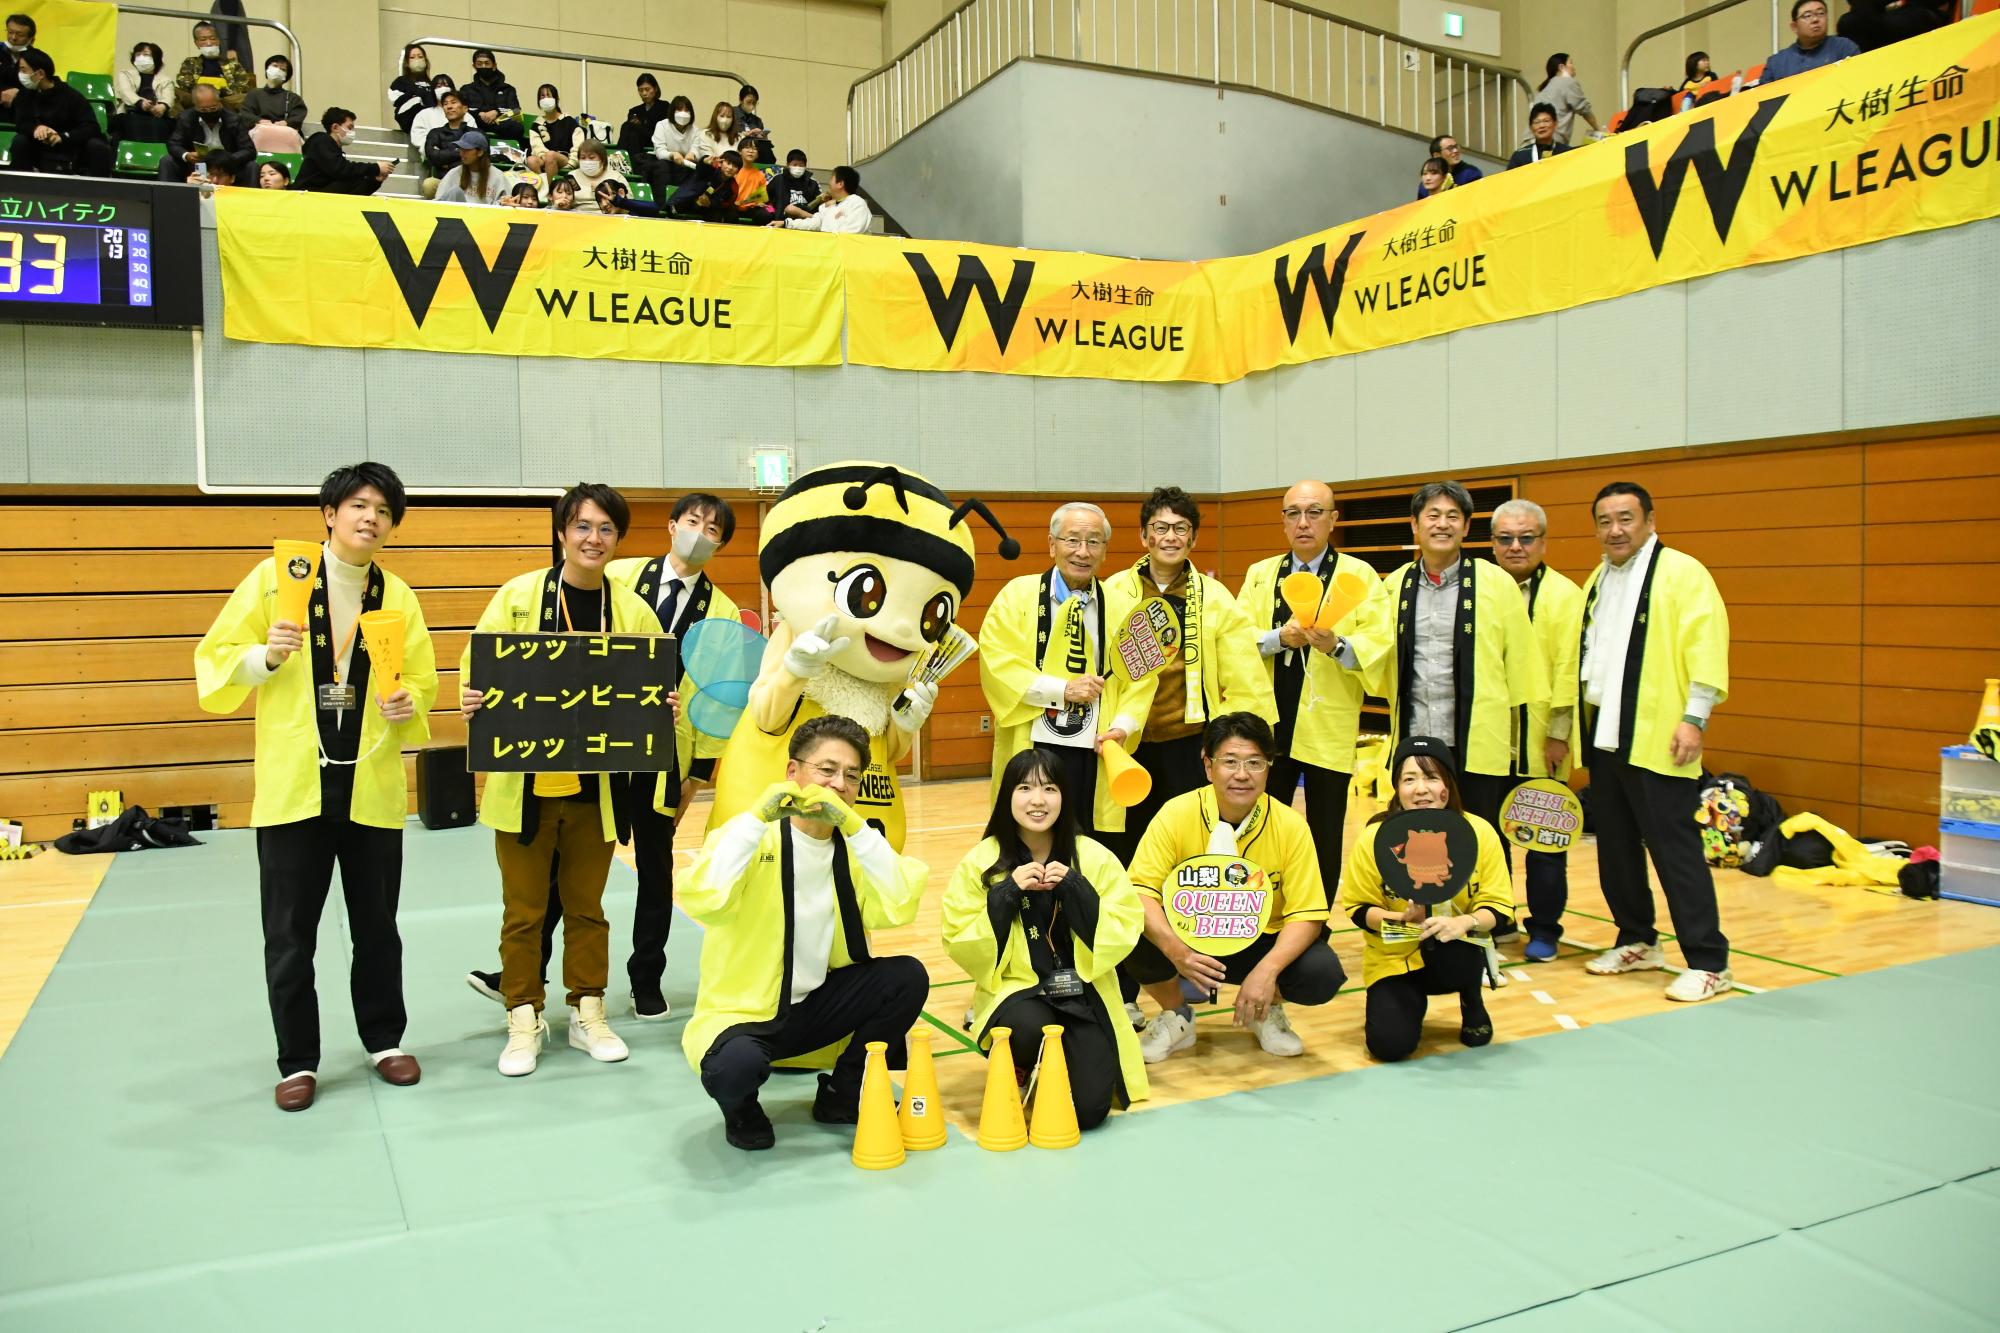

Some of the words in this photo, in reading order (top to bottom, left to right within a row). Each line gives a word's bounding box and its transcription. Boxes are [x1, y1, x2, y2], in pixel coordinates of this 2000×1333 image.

[1825, 65, 1968, 131] 大樹生命
[1625, 94, 1790, 262] W
[1770, 165, 1818, 211] W
[1830, 120, 2000, 201] LEAGU
[1, 198, 116, 222] 立ハイテク
[103, 228, 123, 244] 20
[132, 233, 147, 244] 1Q
[1382, 218, 1458, 261] 大樹生命
[108, 244, 123, 259] 13
[132, 248, 148, 259] 2Q
[582, 246, 693, 276] 大樹生命
[132, 263, 148, 274] 3Q
[361, 211, 538, 335] W
[132, 278, 149, 289] 4Q
[1071, 279, 1154, 307] 大樹生命
[1274, 231, 1367, 347] W
[1354, 284, 1380, 315] W
[1387, 254, 1486, 311] LEAGUE
[133, 294, 148, 303] OT
[535, 288, 578, 318] W
[589, 291, 732, 329] LEAGUE
[902, 252, 1036, 357] W
[1034, 317, 1068, 344] W
[1075, 319, 1184, 352] LEAGUE
[1146, 600, 1169, 632] 山梨
[495, 637, 567, 660] レッツ
[1128, 611, 1165, 671] QUEEN
[1118, 635, 1149, 681] BEES
[483, 684, 664, 710] クィーンビーズ
[493, 737, 565, 759] レッツ
[1514, 787, 1566, 811] BEES
[1504, 804, 1578, 832] QUEEN
[1537, 828, 1571, 848] 山梨
[1178, 865, 1220, 888] 山梨
[1172, 890, 1267, 917] QUEEN
[1194, 914, 1260, 938] BEES
